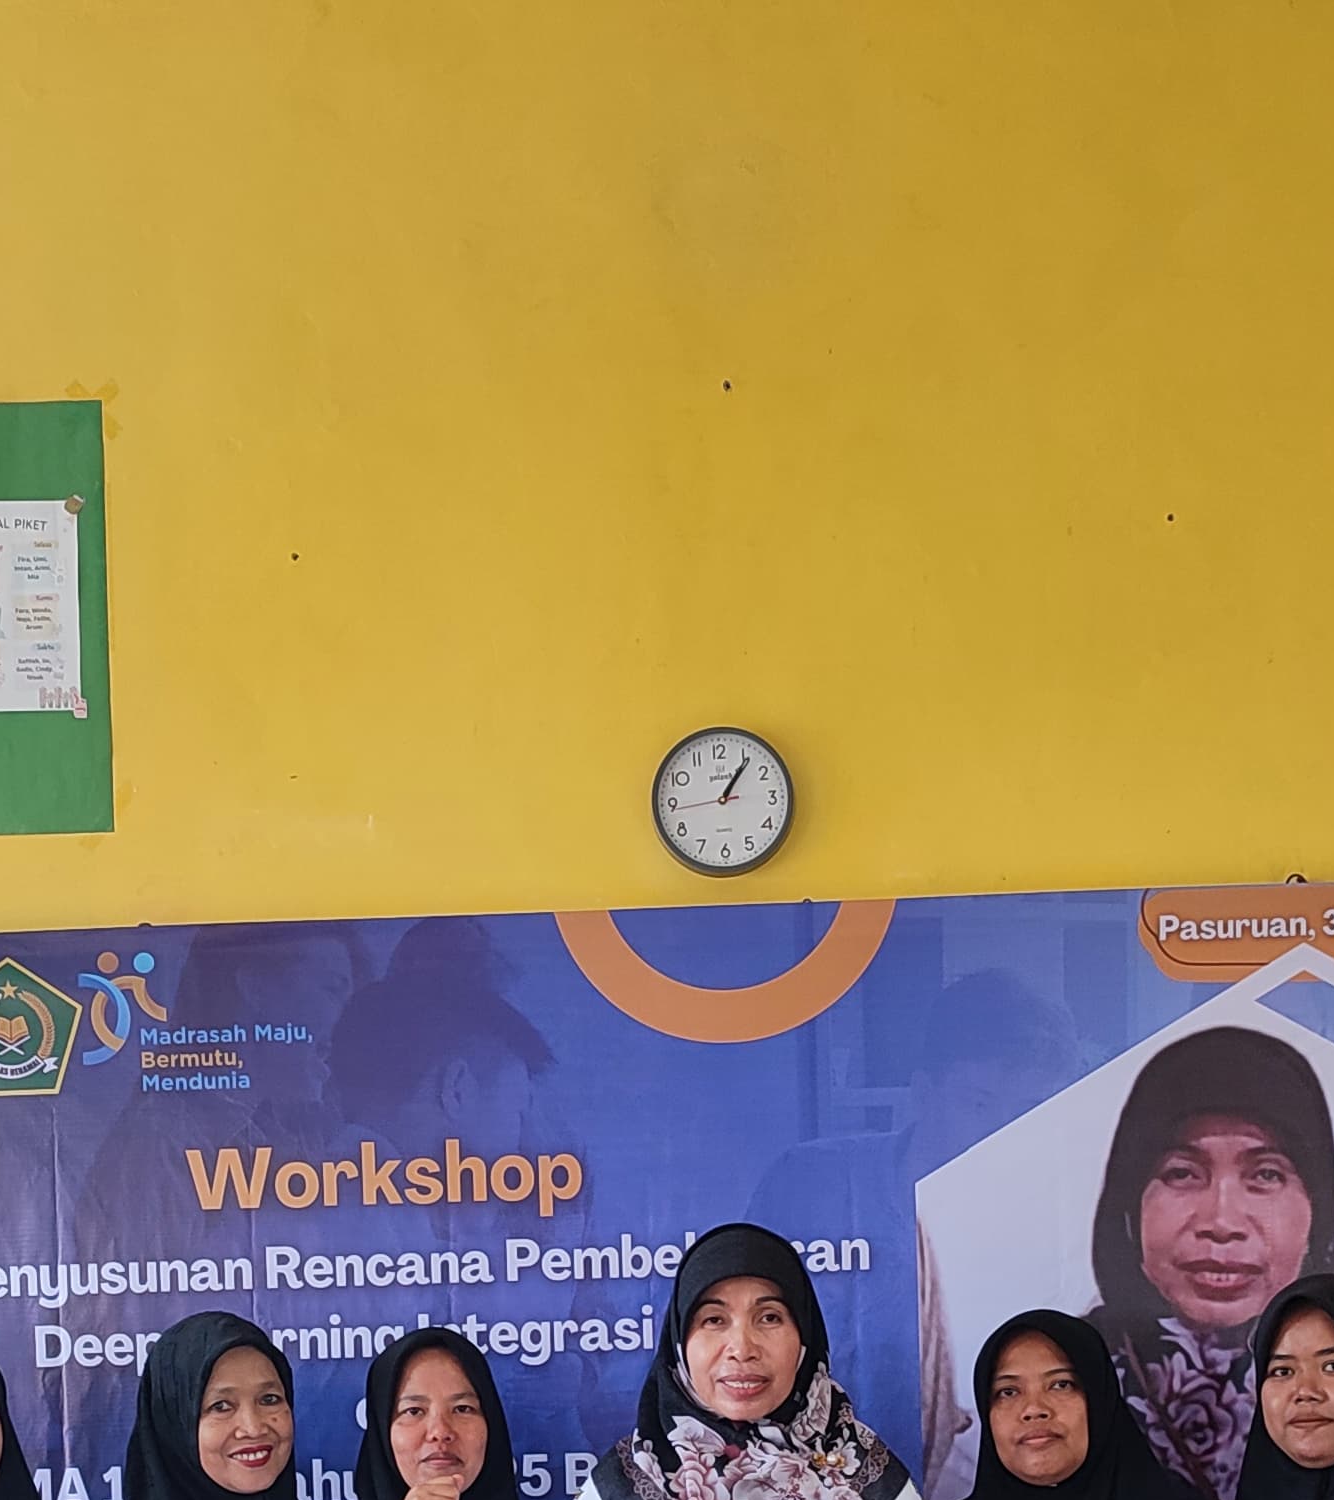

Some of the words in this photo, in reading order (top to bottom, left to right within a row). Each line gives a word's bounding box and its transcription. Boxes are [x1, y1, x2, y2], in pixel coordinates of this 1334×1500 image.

[14, 518, 48, 532] PIKET
[692, 751, 701, 767] 11
[712, 744, 726, 760] 12
[671, 771, 690, 787] 10
[758, 765, 769, 781] 2
[667, 797, 678, 812] 9
[767, 790, 778, 805] 3
[677, 822, 687, 837] 8
[761, 816, 773, 831] 4
[696, 839, 707, 854] 7
[720, 843, 731, 858] 6
[744, 836, 755, 851] 5
[1158, 912, 1316, 942] Pasuruan,
[140, 1023, 246, 1046] Madrasah
[255, 1022, 313, 1045] Maju,
[141, 1047, 243, 1070] Bermutu,
[142, 1071, 251, 1092] Mendunia
[185, 1138, 583, 1218] Workshop
[265, 1245, 495, 1289] Rencana
[505, 1231, 871, 1282] Pembean
[34, 1324, 160, 1377] Deep
